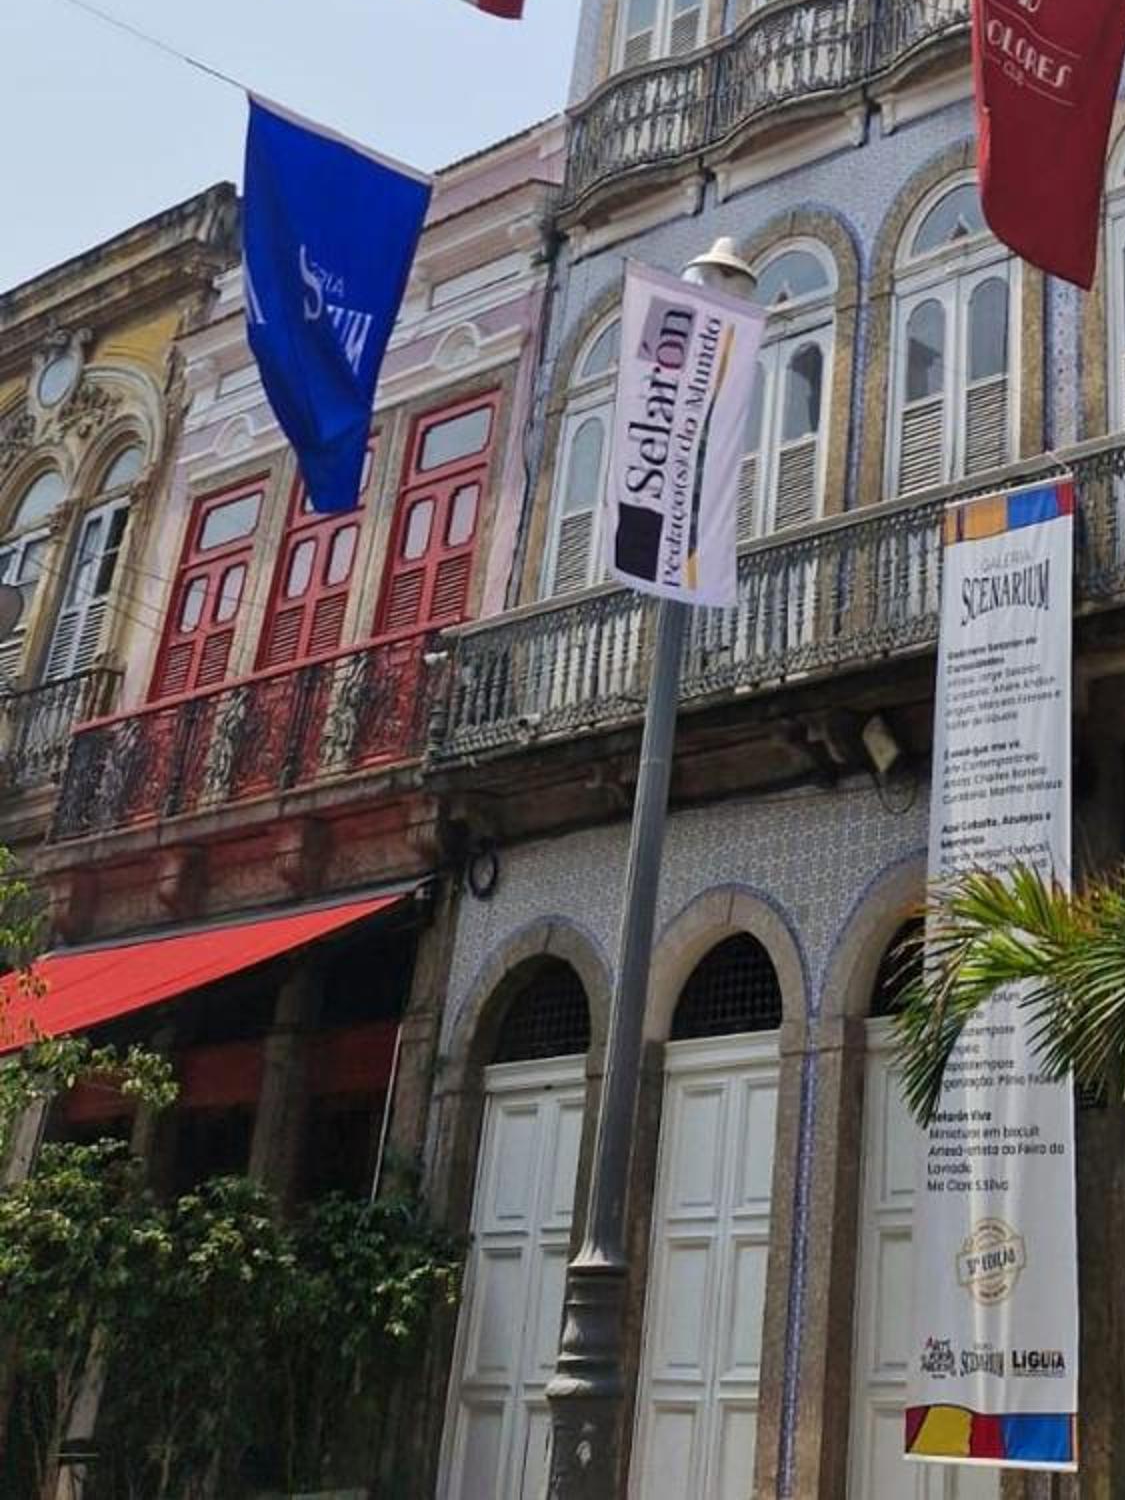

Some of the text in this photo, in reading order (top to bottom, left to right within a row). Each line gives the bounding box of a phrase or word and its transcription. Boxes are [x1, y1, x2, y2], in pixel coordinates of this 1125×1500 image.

[684, 315, 722, 411] Mundo
[625, 308, 693, 501] Selarón
[676, 417, 699, 452] do
[960, 558, 1051, 627] SCENARIUM
